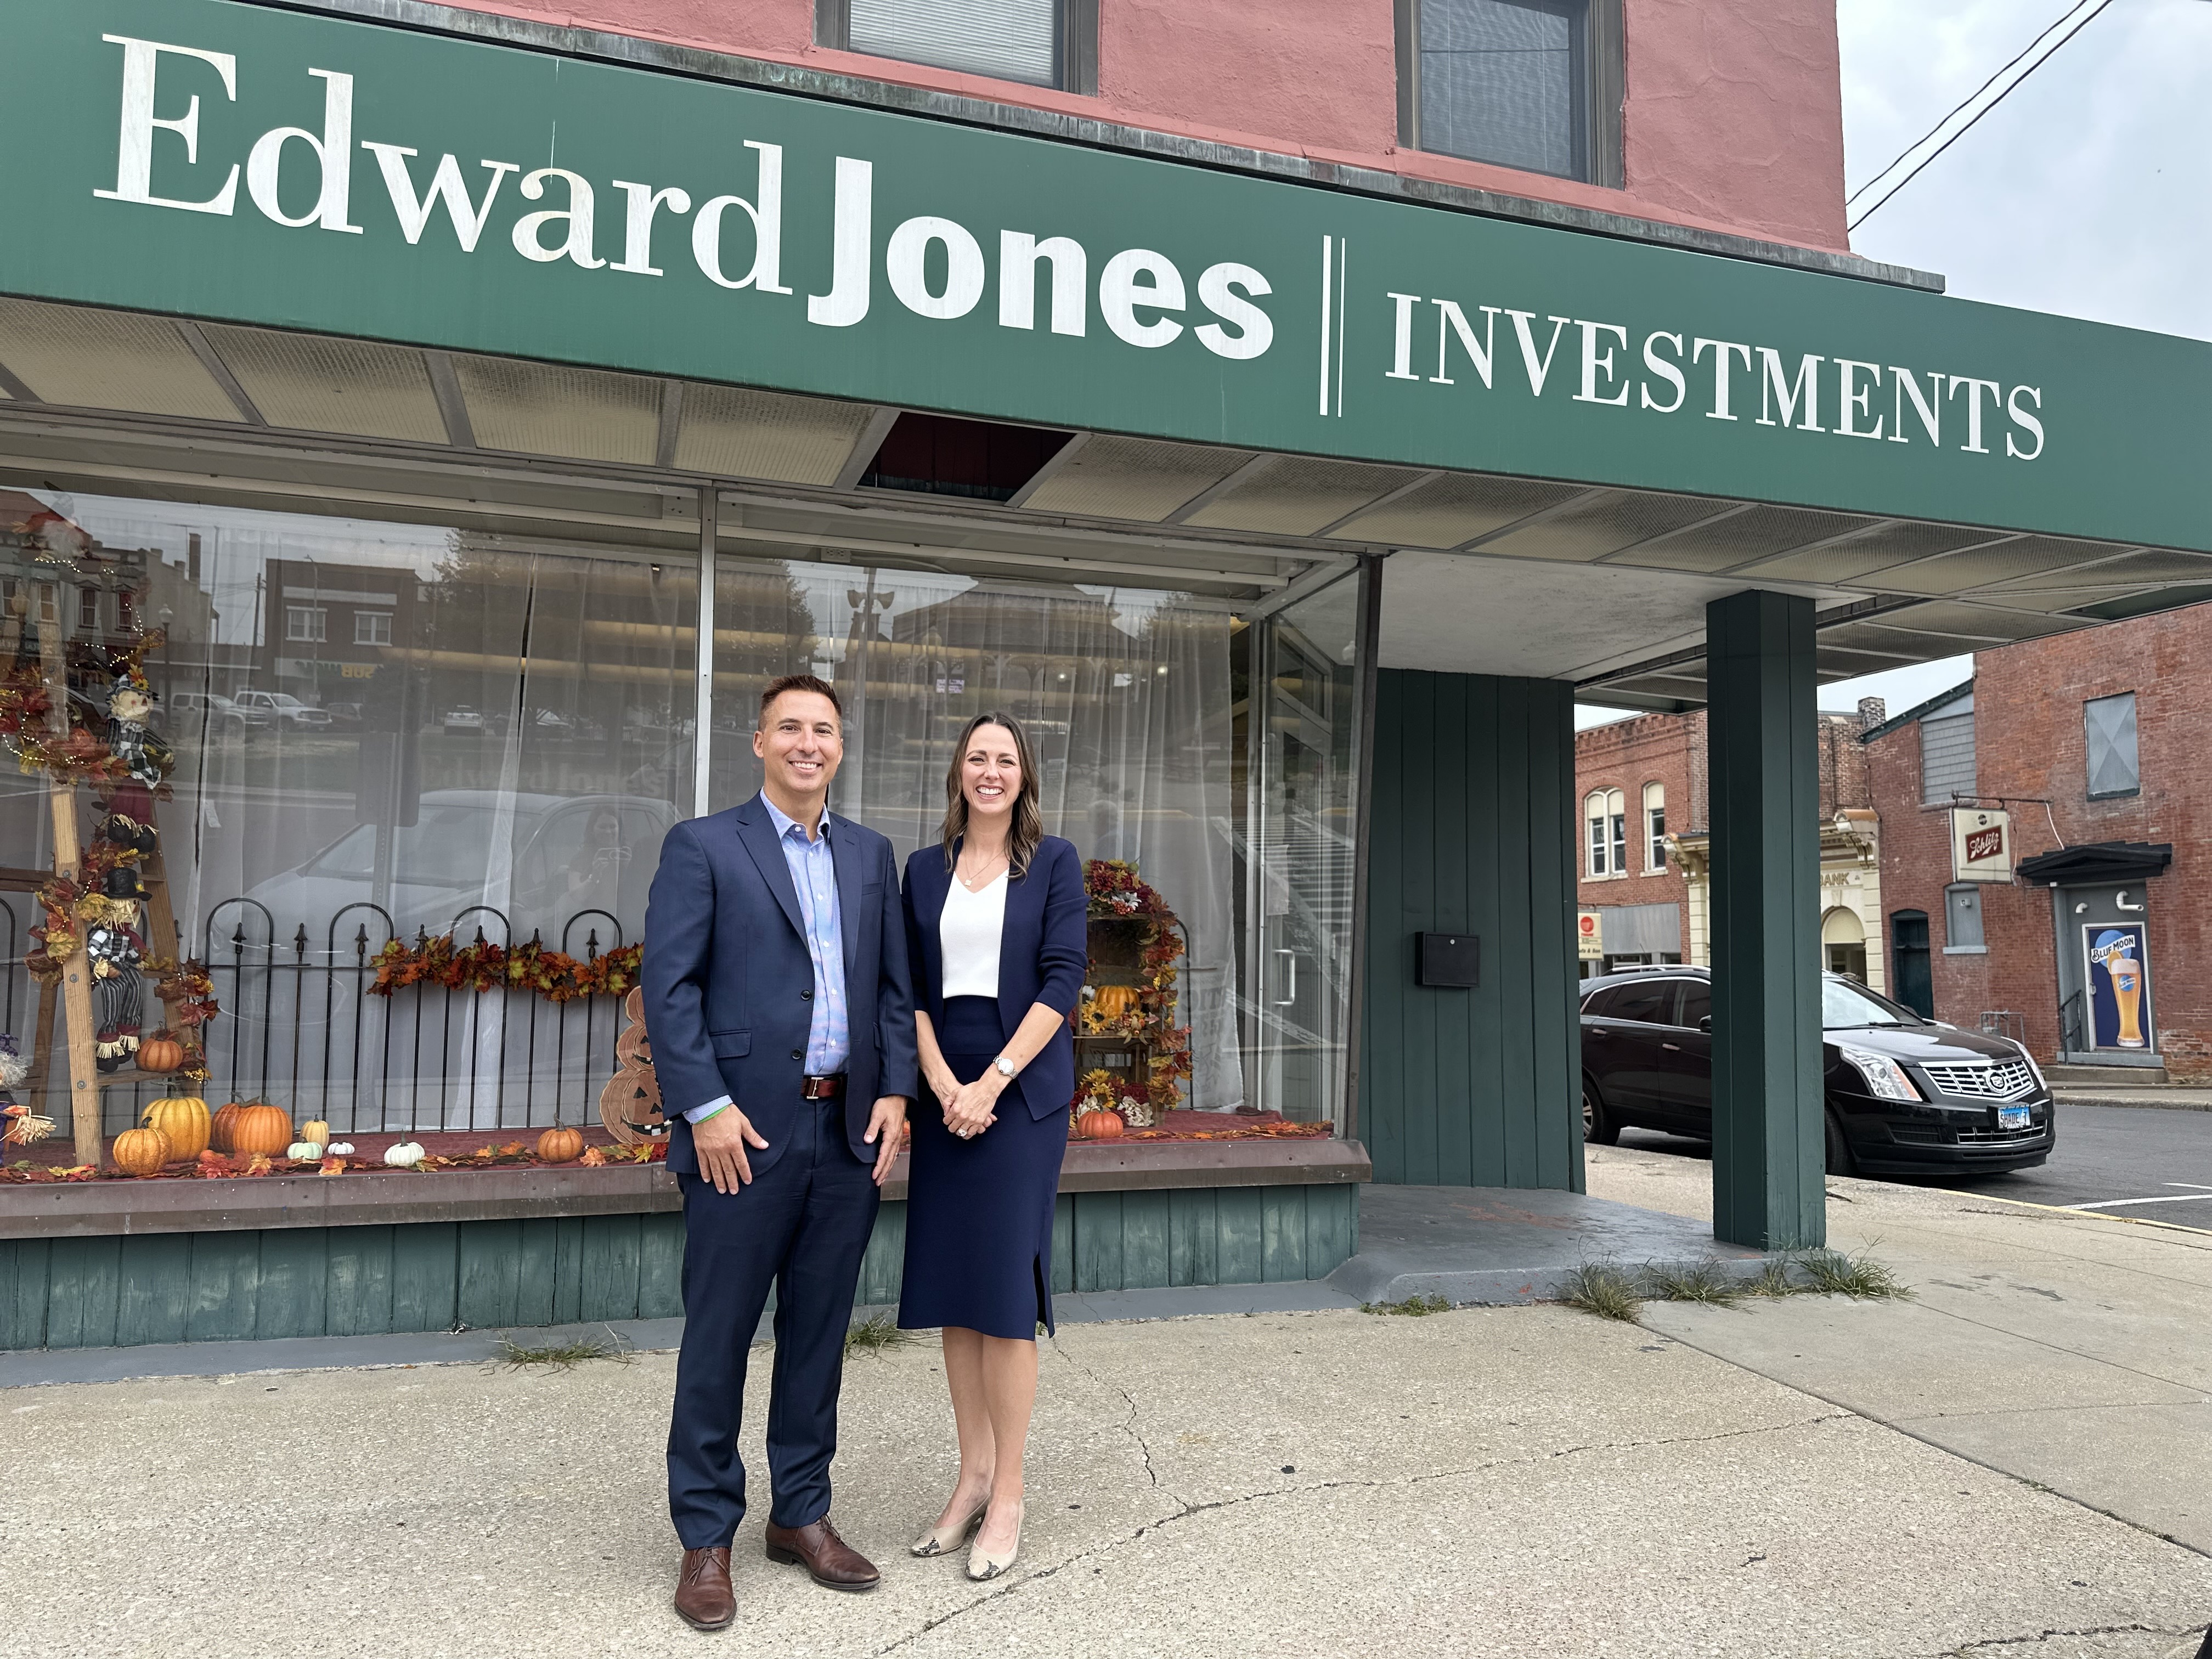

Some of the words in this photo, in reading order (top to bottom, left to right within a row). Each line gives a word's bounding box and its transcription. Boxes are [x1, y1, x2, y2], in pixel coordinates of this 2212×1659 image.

[93, 33, 793, 295] Edward
[807, 156, 1273, 360] Jones
[1385, 292, 2044, 460] INVESTMENTS
[1970, 831, 2000, 859] Schlitz
[2113, 937, 2134, 951] MOON
[2000, 1112, 2019, 1125] SHADE
